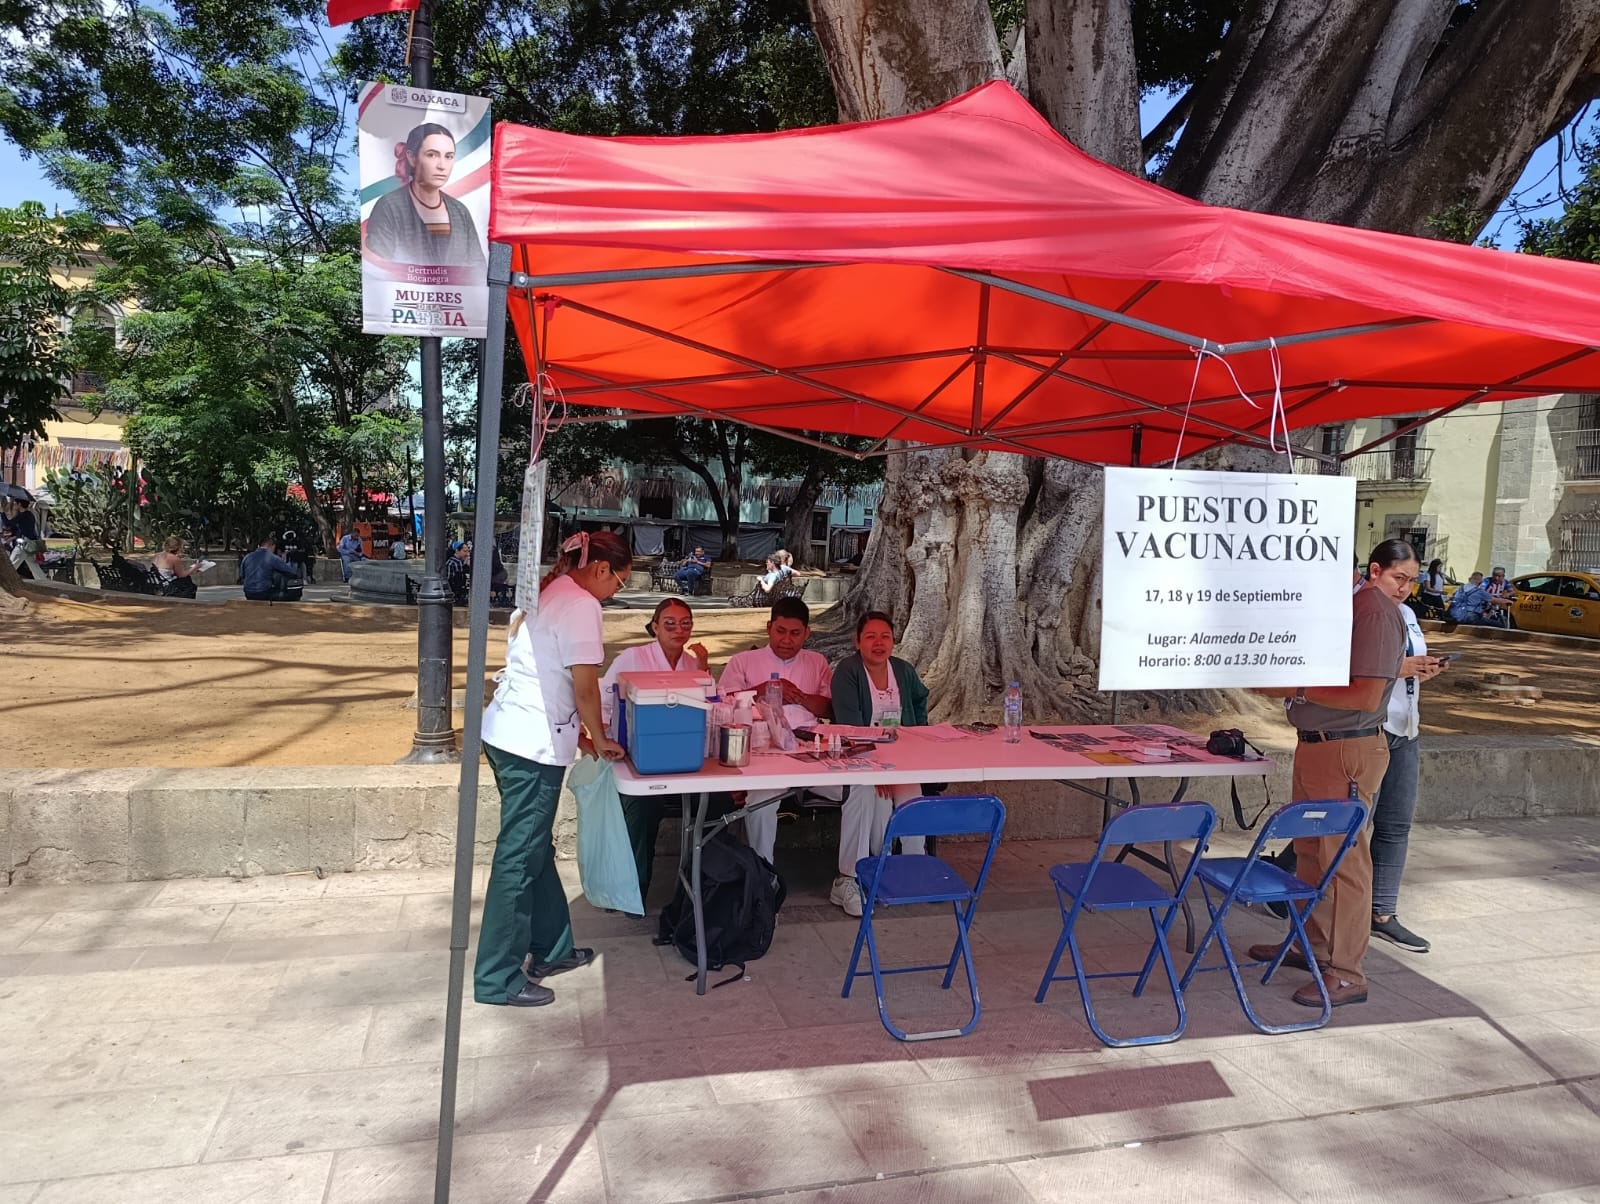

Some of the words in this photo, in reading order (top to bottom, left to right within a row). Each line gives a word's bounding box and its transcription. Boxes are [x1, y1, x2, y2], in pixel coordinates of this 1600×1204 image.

[411, 92, 459, 107] OAXACA
[408, 265, 448, 275] Gertrudis
[407, 274, 449, 284] Bocanegra
[395, 289, 462, 304] MUJERES
[391, 309, 467, 327] PATRIA
[1137, 495, 1268, 524] PUESTO
[1278, 498, 1319, 525] DE
[1115, 528, 1341, 562] VACUNACIÓN
[1145, 589, 1164, 604] 17,
[1168, 589, 1183, 602] 18
[1186, 592, 1194, 605] y
[1197, 589, 1212, 602] 19
[1215, 589, 1231, 602] de
[1233, 589, 1303, 605] Septiembre
[1522, 594, 1546, 602] TAXI
[1147, 633, 1187, 647] Lugar:
[1189, 632, 1246, 645] Alameda
[1248, 632, 1265, 645] De
[1268, 630, 1297, 644] León
[1138, 655, 1191, 667] Horario:
[1193, 654, 1222, 666] 8:00
[1224, 656, 1232, 666] a
[1233, 653, 1267, 666] 13.30
[1269, 653, 1306, 666] horas.
